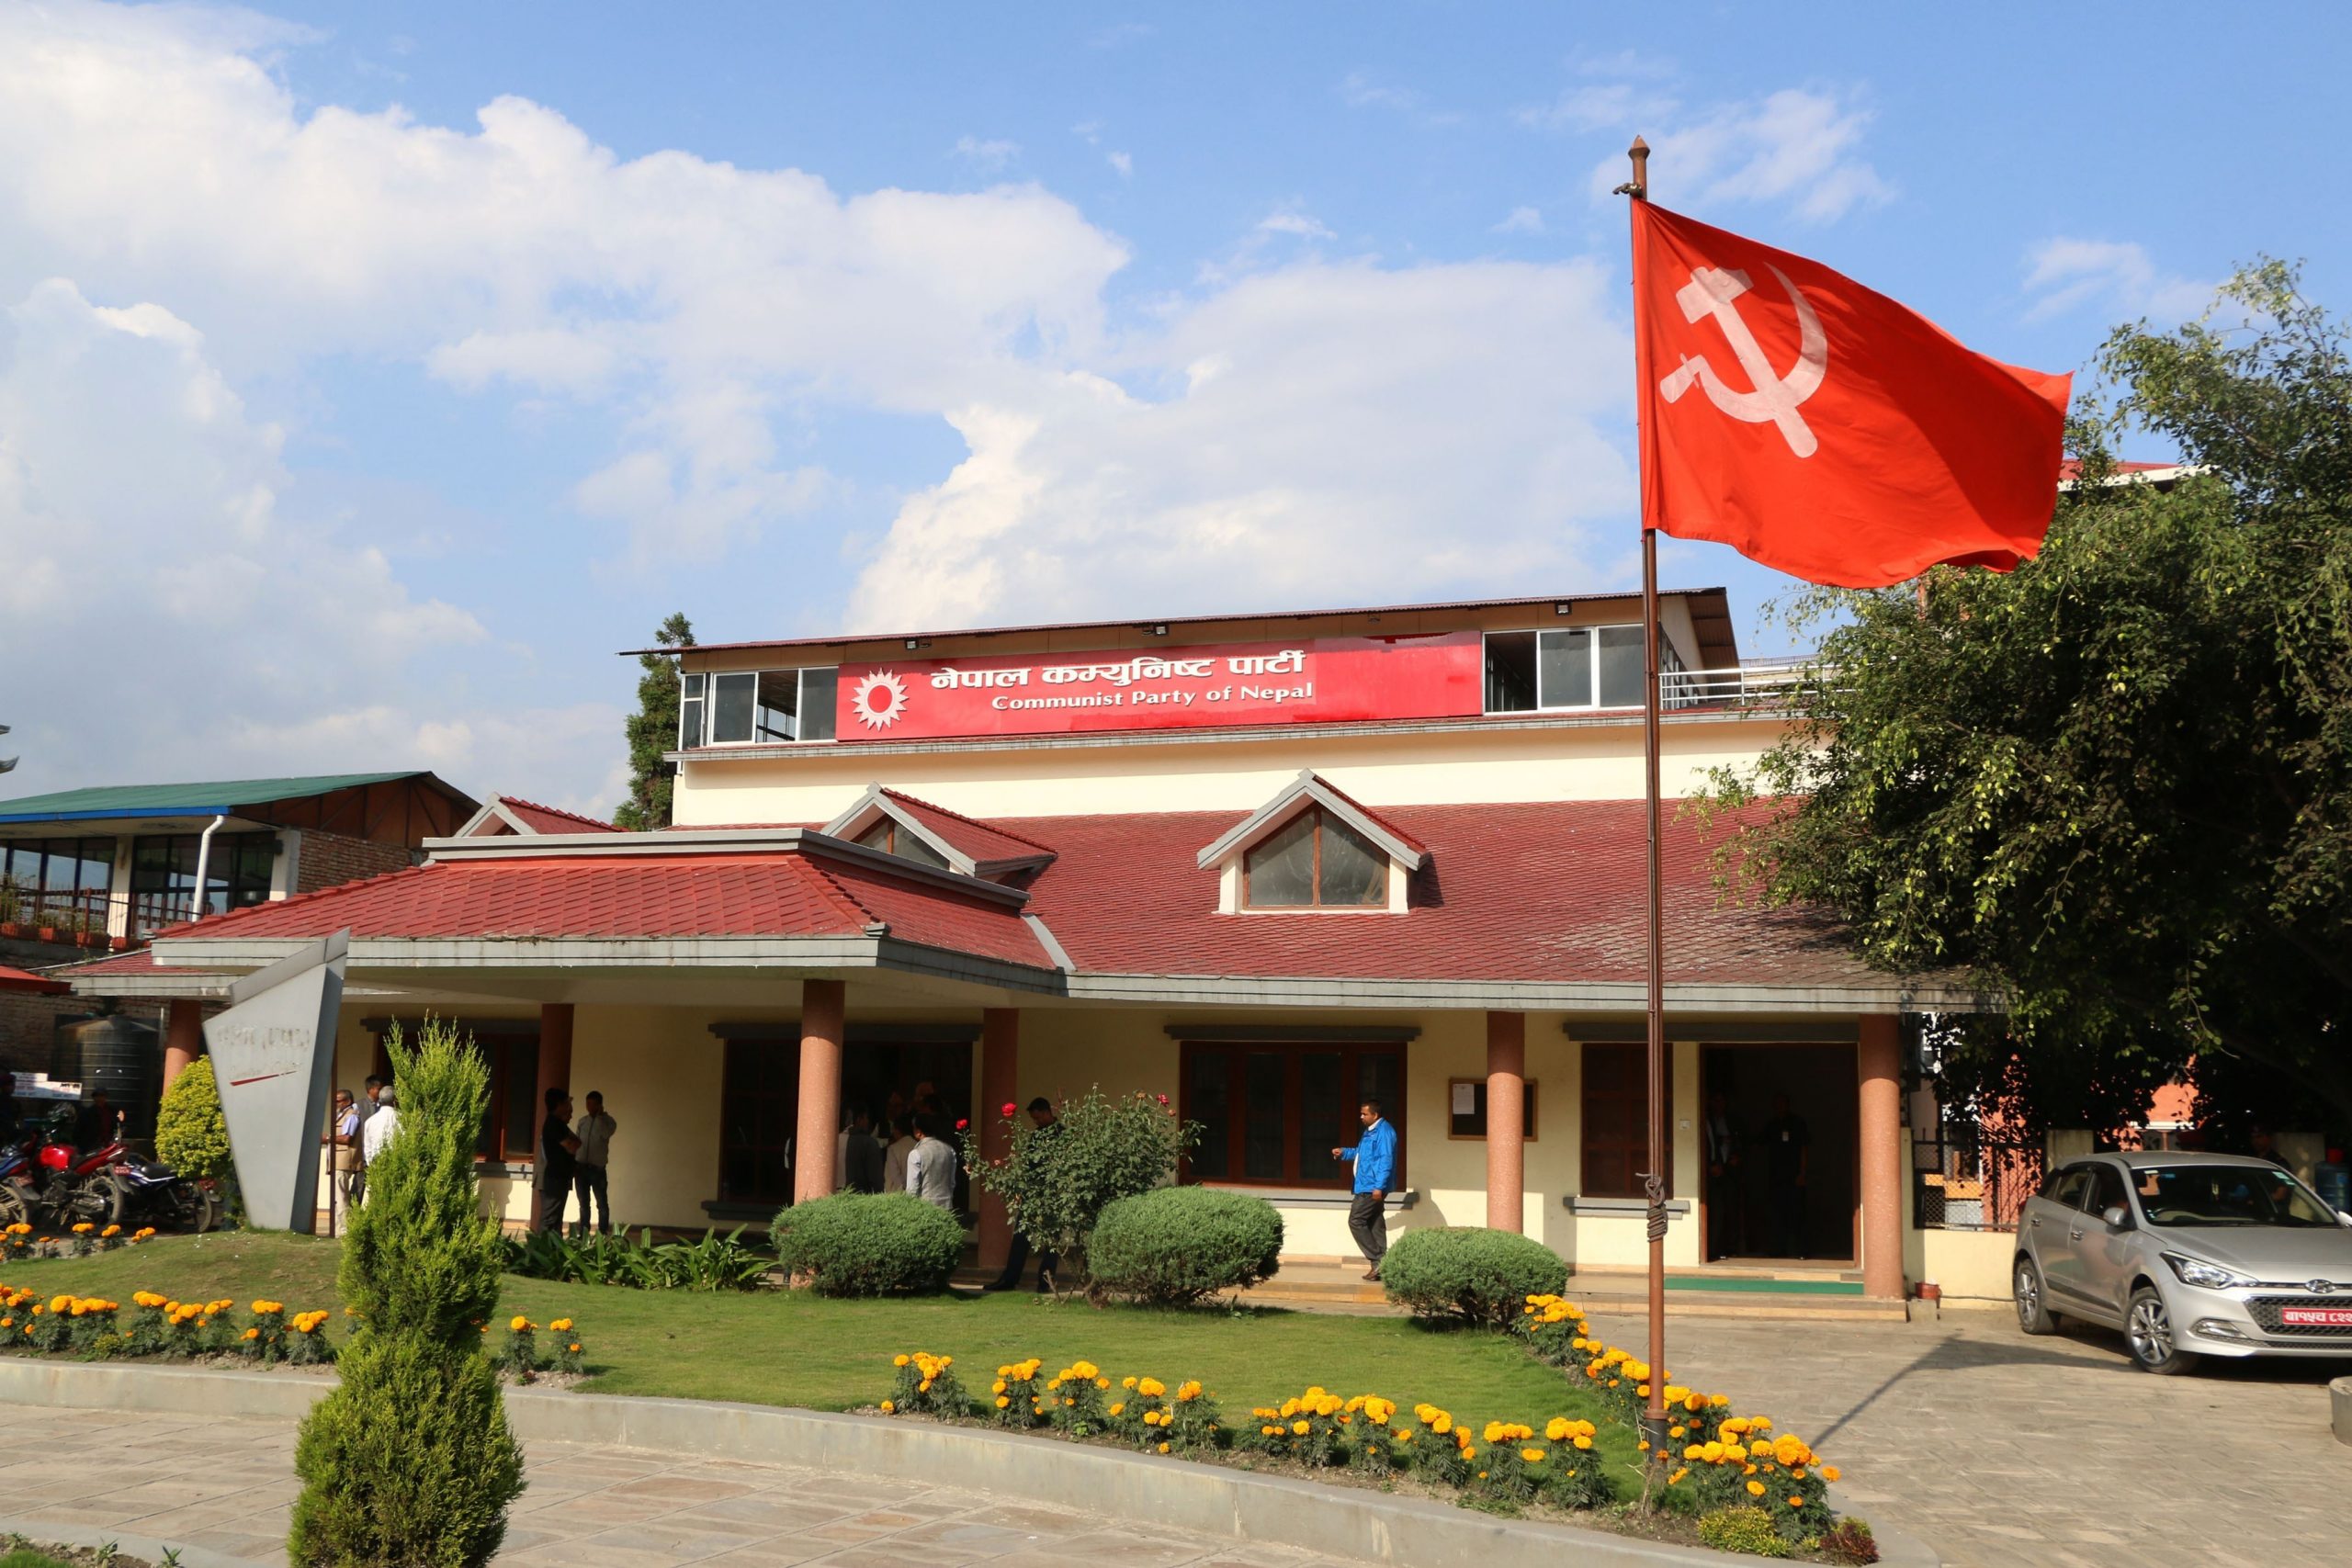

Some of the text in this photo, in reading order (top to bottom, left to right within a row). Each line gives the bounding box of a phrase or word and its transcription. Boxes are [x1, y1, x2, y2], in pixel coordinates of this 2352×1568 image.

[931, 649, 1306, 689] नेपाल कम्युनिष्ट पार्टी
[991, 682, 1313, 710] Communist Party of Nepal
